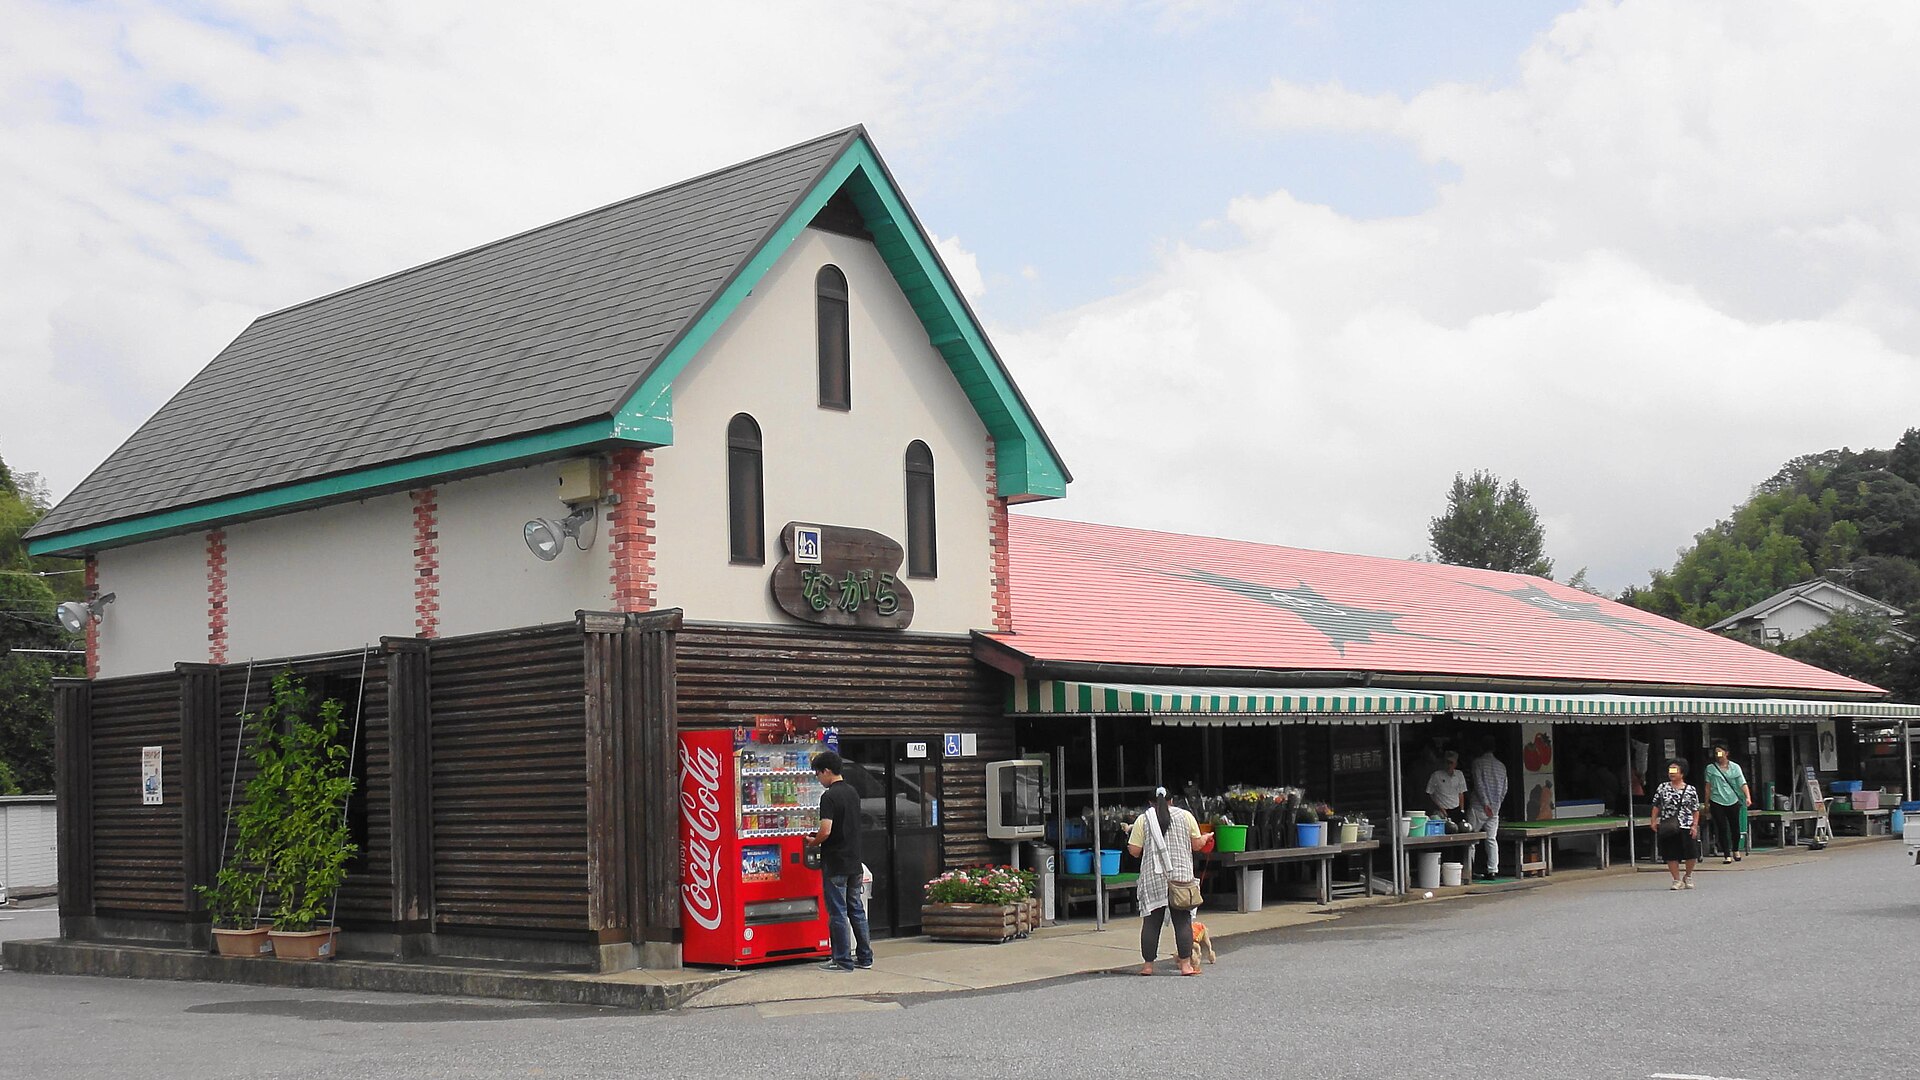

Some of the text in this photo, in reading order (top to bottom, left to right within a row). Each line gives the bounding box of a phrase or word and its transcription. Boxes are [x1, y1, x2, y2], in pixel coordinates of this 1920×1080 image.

[801, 565, 900, 616] ながら
[679, 738, 722, 931] Coca-Cola
